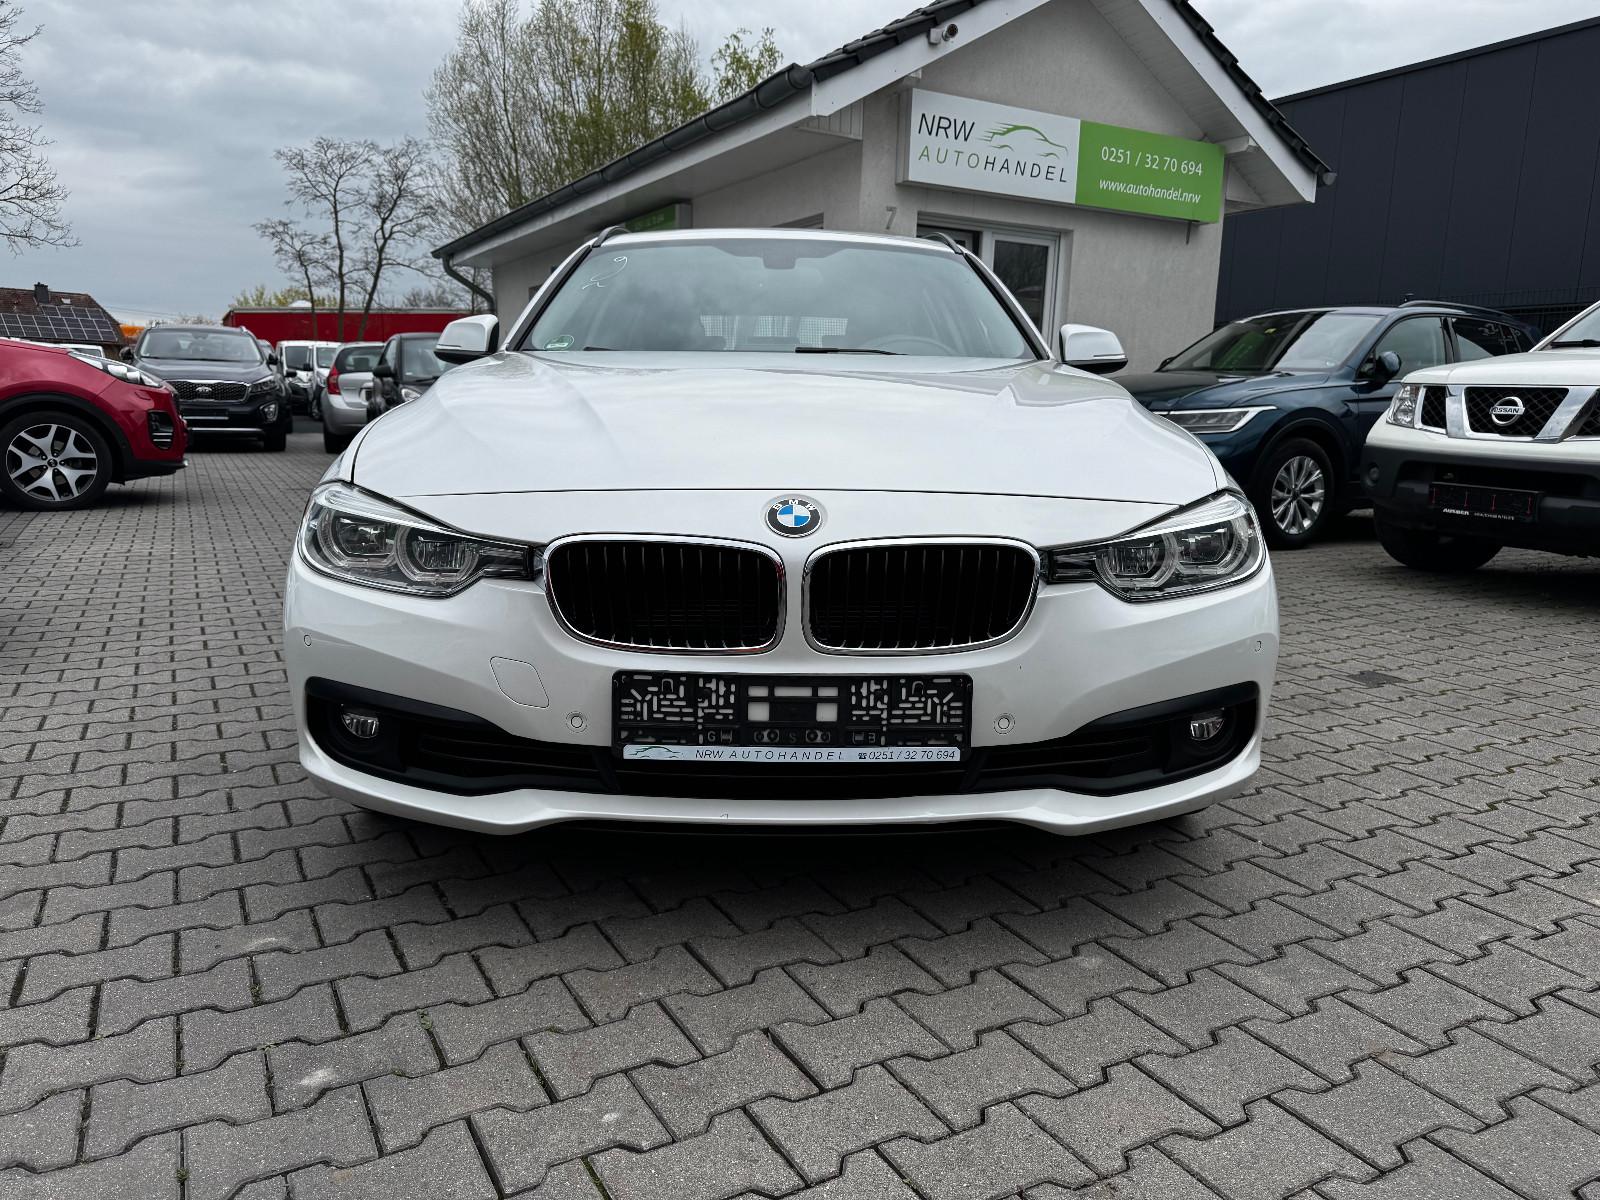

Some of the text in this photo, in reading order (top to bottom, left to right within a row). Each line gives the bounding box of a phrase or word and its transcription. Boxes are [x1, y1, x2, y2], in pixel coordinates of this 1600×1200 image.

[918, 113, 975, 142] NRW
[918, 145, 1067, 183] AUTOHANDEL
[1101, 146, 1131, 165] 0251
[1145, 154, 1160, 170] 32
[1163, 157, 1177, 172] 70
[1181, 161, 1202, 176] 694
[1099, 179, 1201, 203] www.autohandel.nrw
[886, 206, 897, 230] 7
[772, 499, 817, 511] BMW
[695, 749, 724, 759] NRW
[729, 750, 844, 760] AUTOHANDEL
[868, 750, 894, 760] 0251
[903, 750, 918, 760] 32
[921, 750, 933, 760] 70
[936, 750, 956, 760] 694
